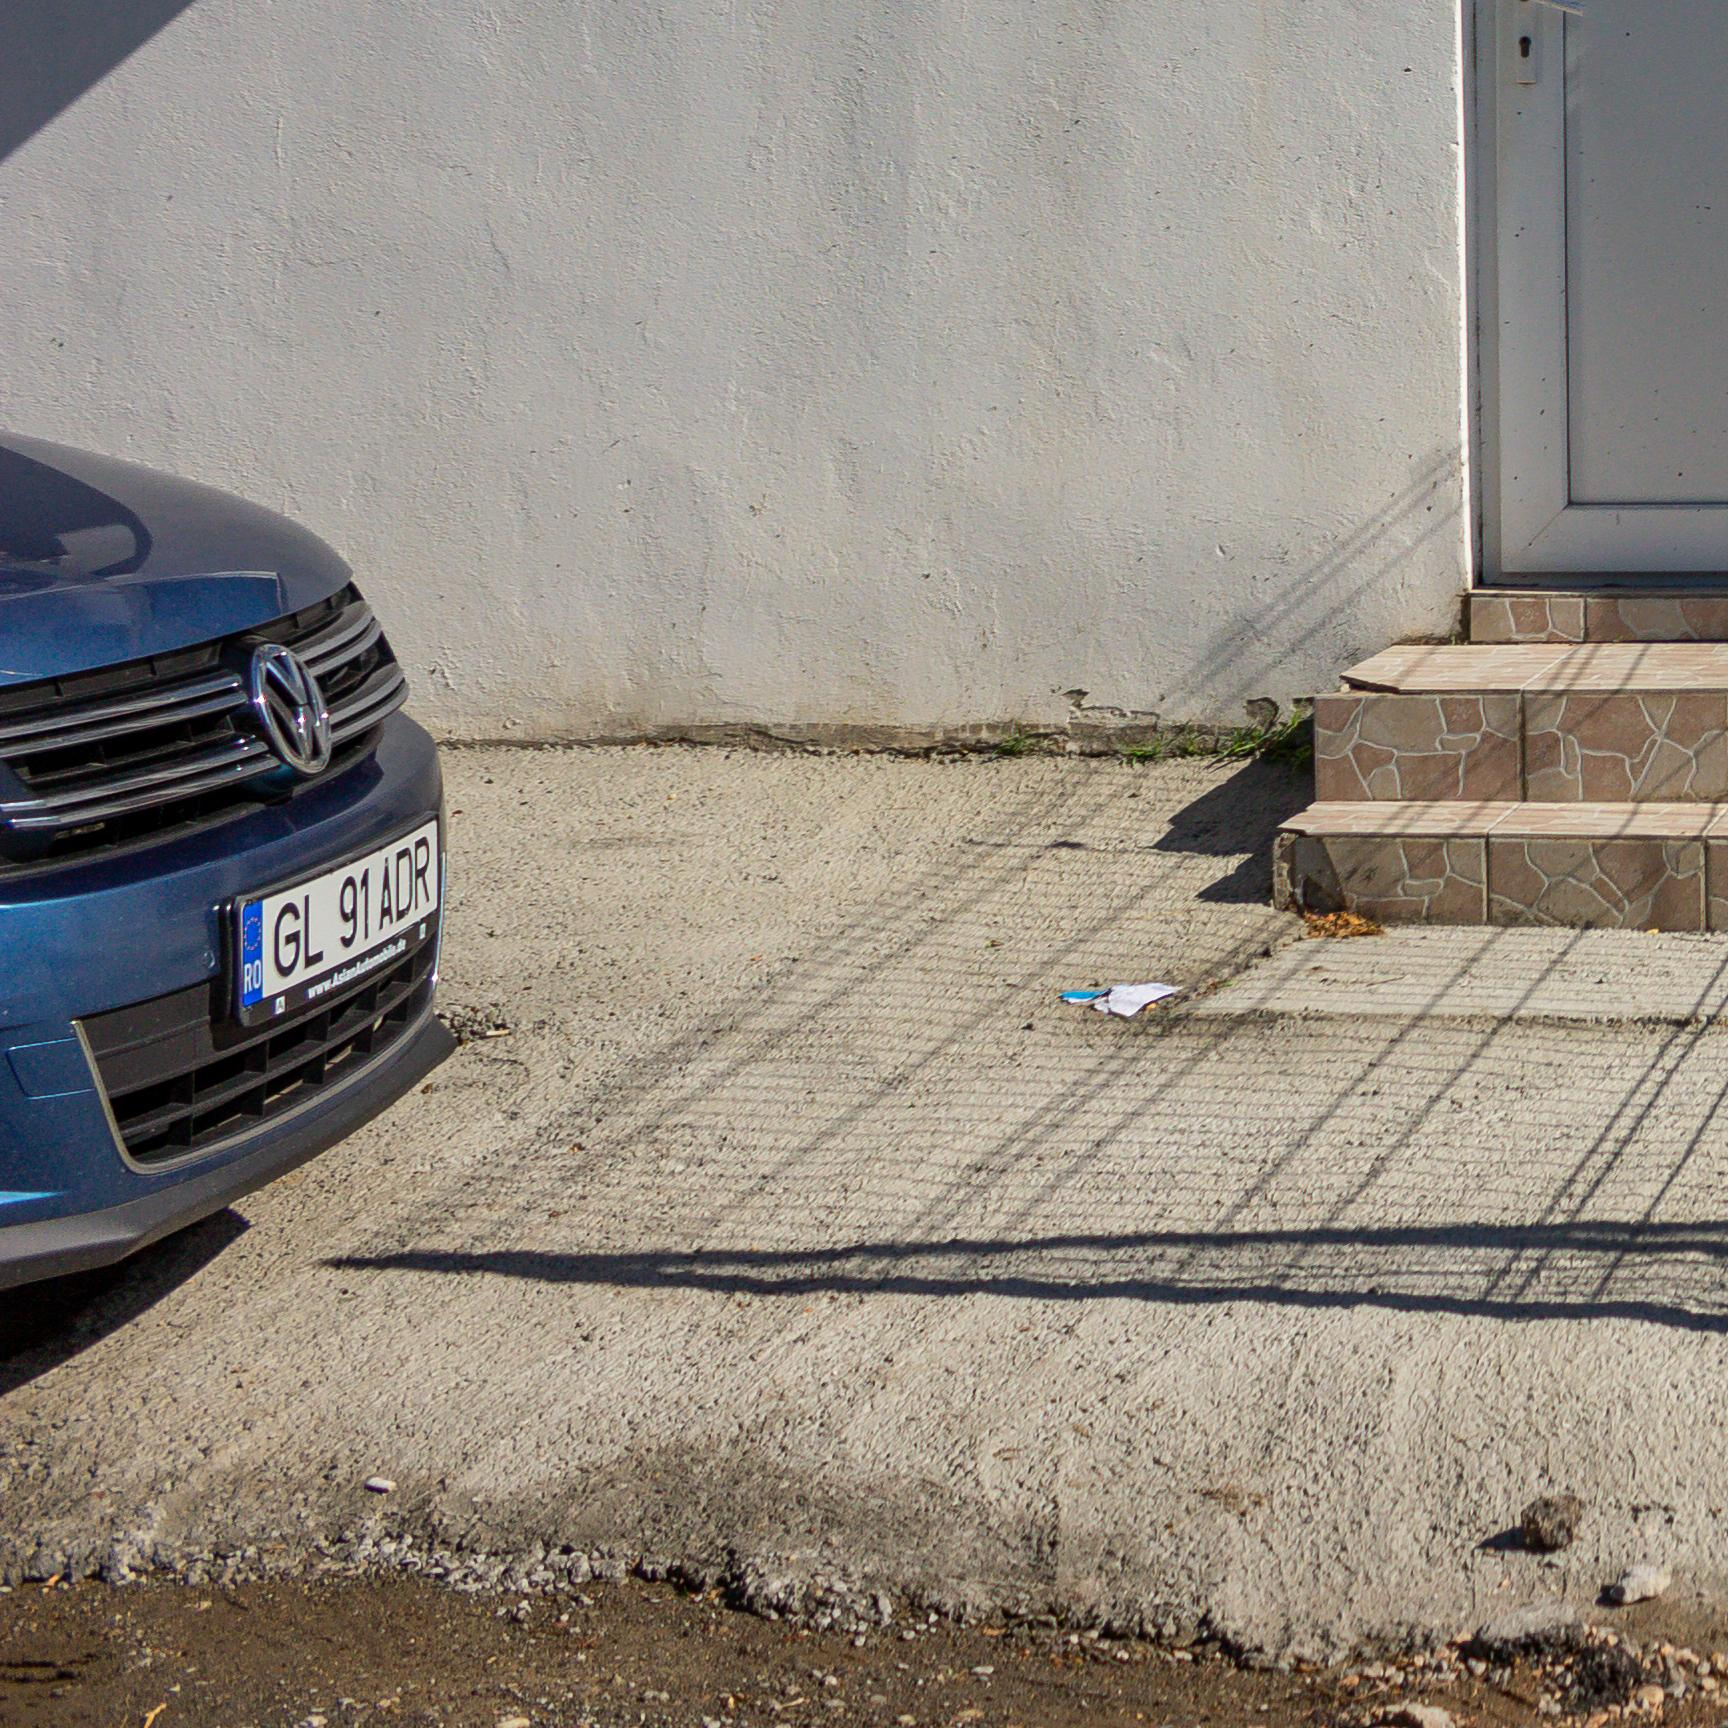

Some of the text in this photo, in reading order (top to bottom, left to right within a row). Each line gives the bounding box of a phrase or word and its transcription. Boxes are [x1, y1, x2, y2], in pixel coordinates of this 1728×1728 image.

[274, 836, 430, 978] GL 91 ADR
[243, 959, 263, 994] RO
